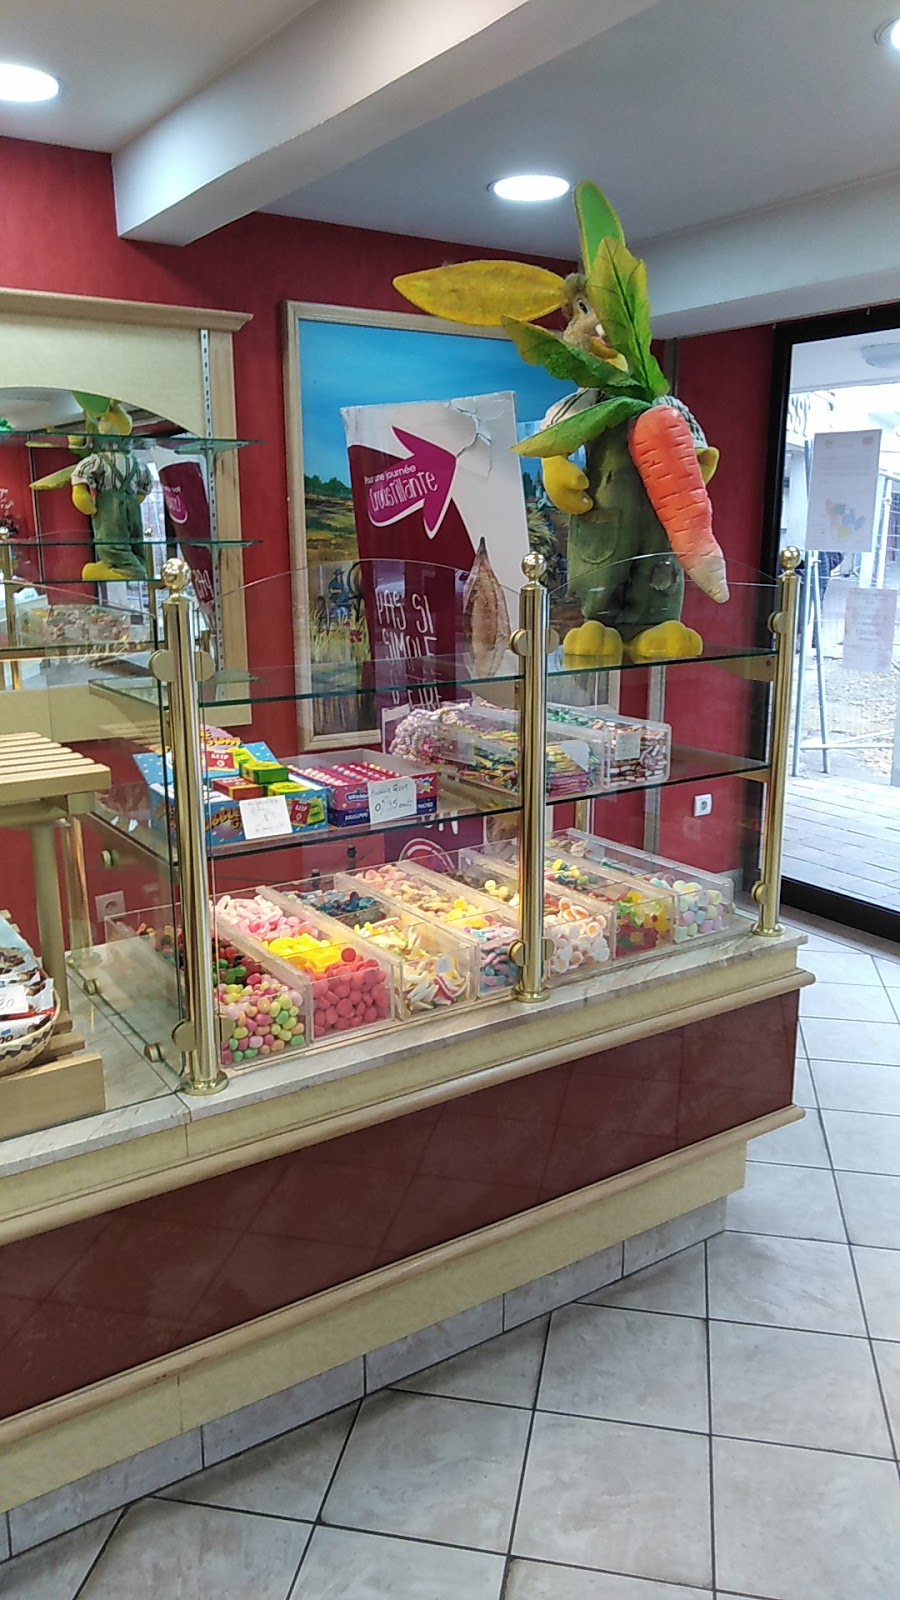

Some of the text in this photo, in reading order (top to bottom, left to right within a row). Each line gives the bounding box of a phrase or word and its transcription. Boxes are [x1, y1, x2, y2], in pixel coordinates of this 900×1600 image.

[385, 464, 417, 481] journée
[375, 589, 434, 634] PAS SI
[381, 627, 438, 668] SIMPLE
